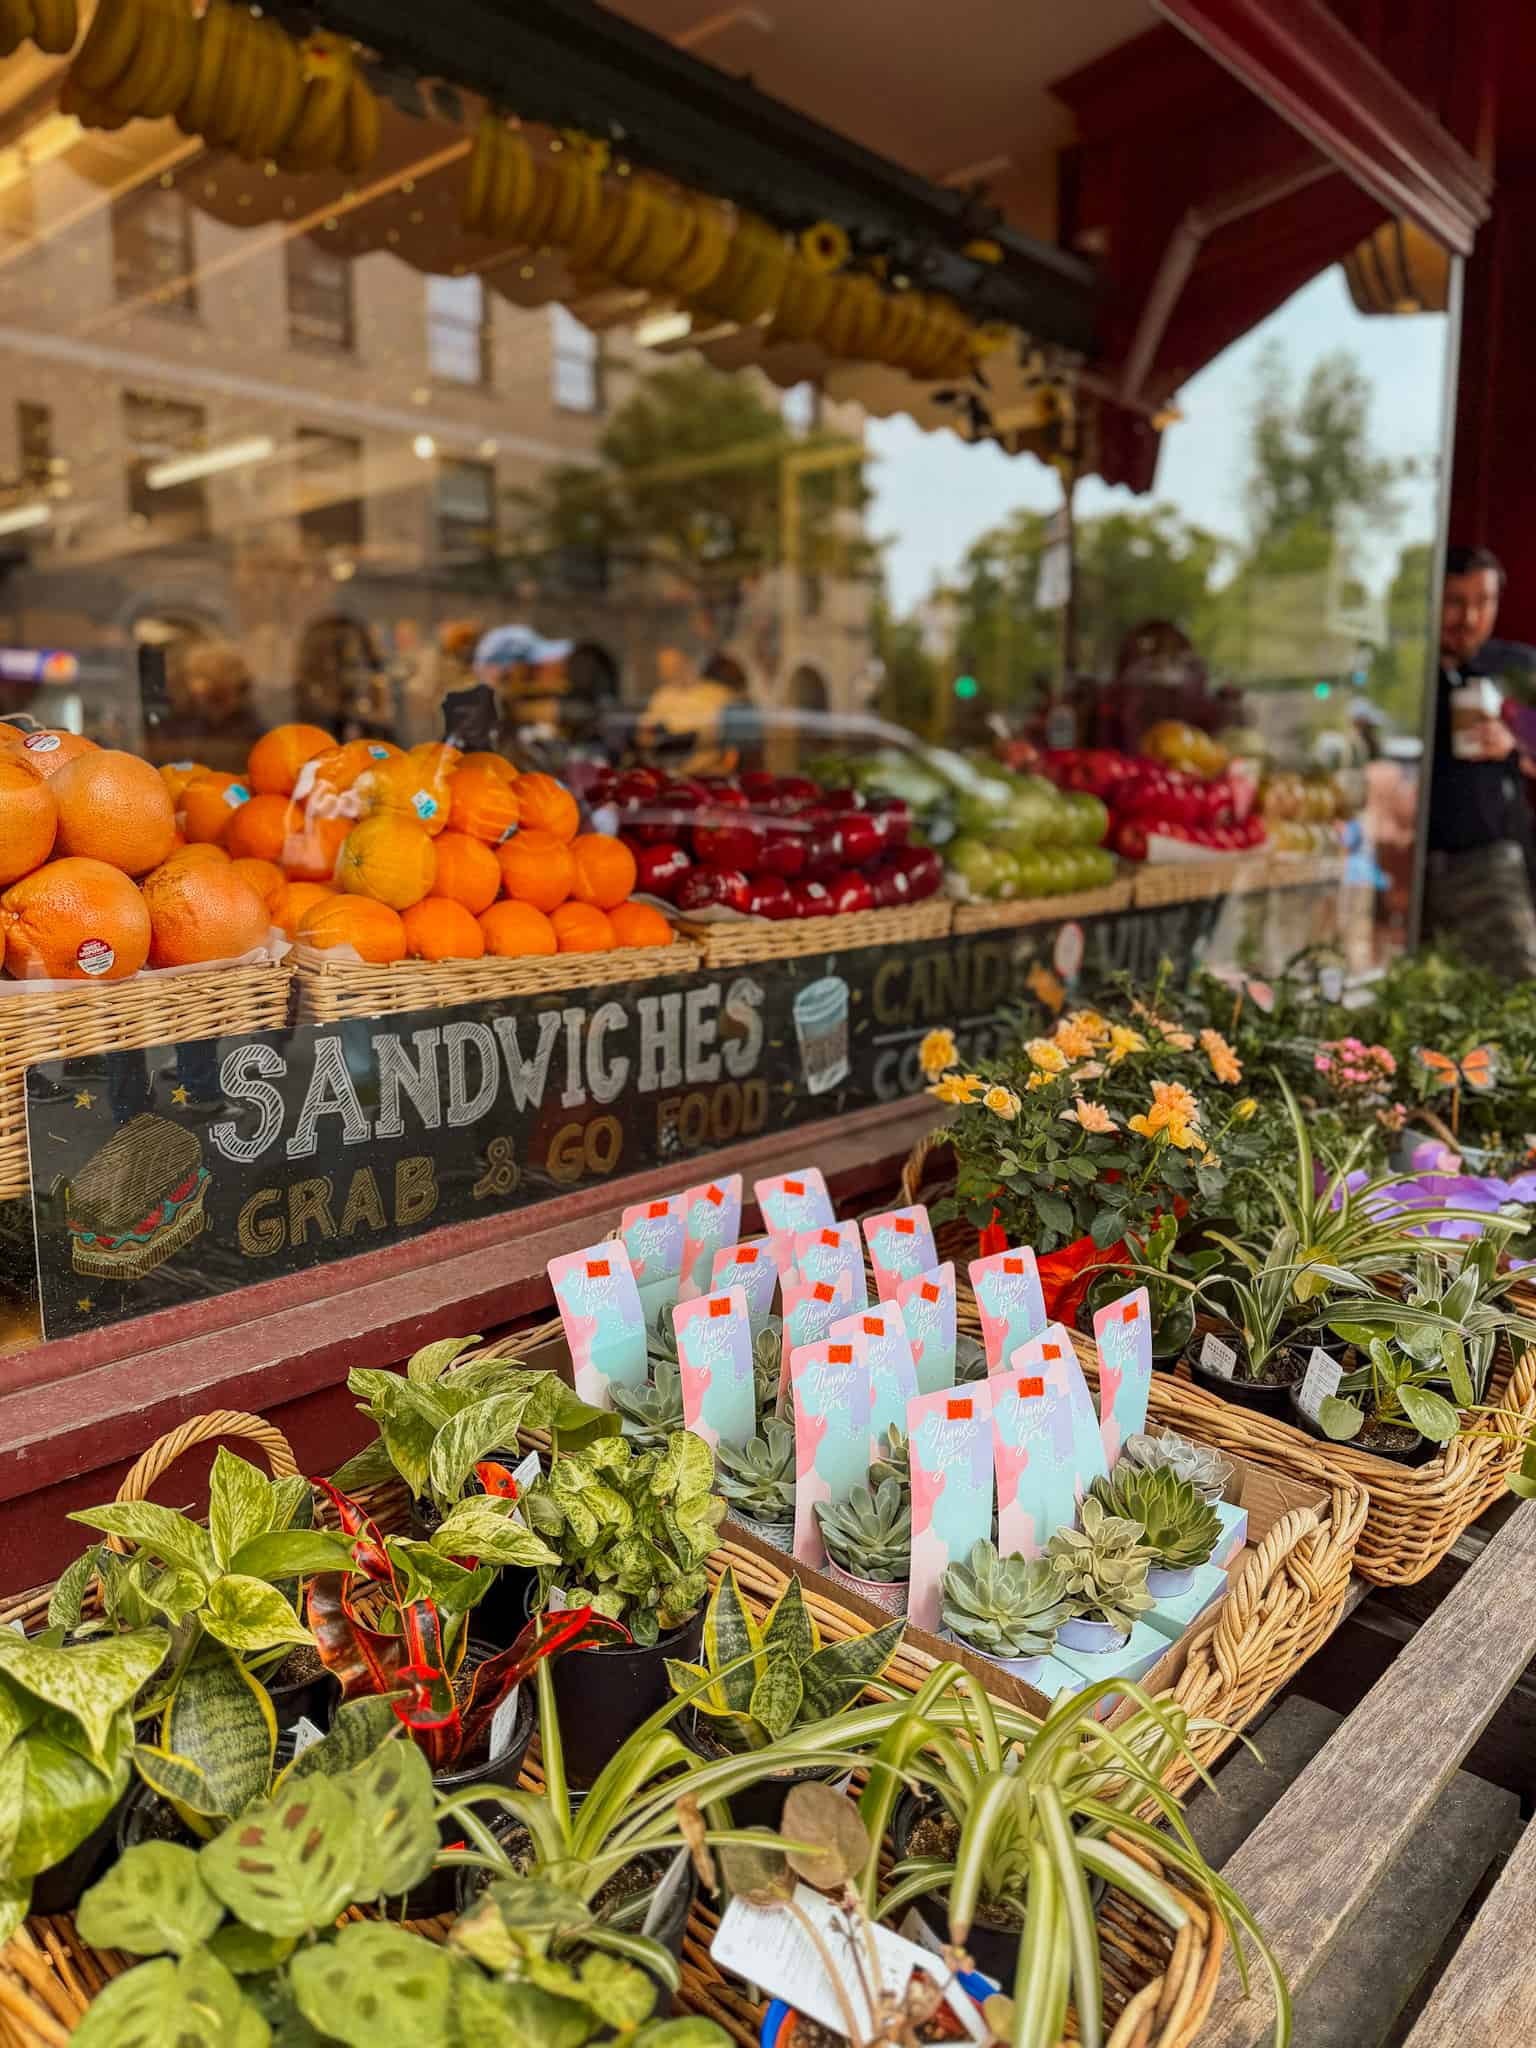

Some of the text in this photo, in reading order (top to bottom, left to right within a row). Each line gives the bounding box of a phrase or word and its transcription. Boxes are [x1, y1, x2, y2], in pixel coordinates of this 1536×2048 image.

[209, 977, 765, 1162] SANDWICHES
[238, 1079, 768, 1257] GRAB & GO FOOD
